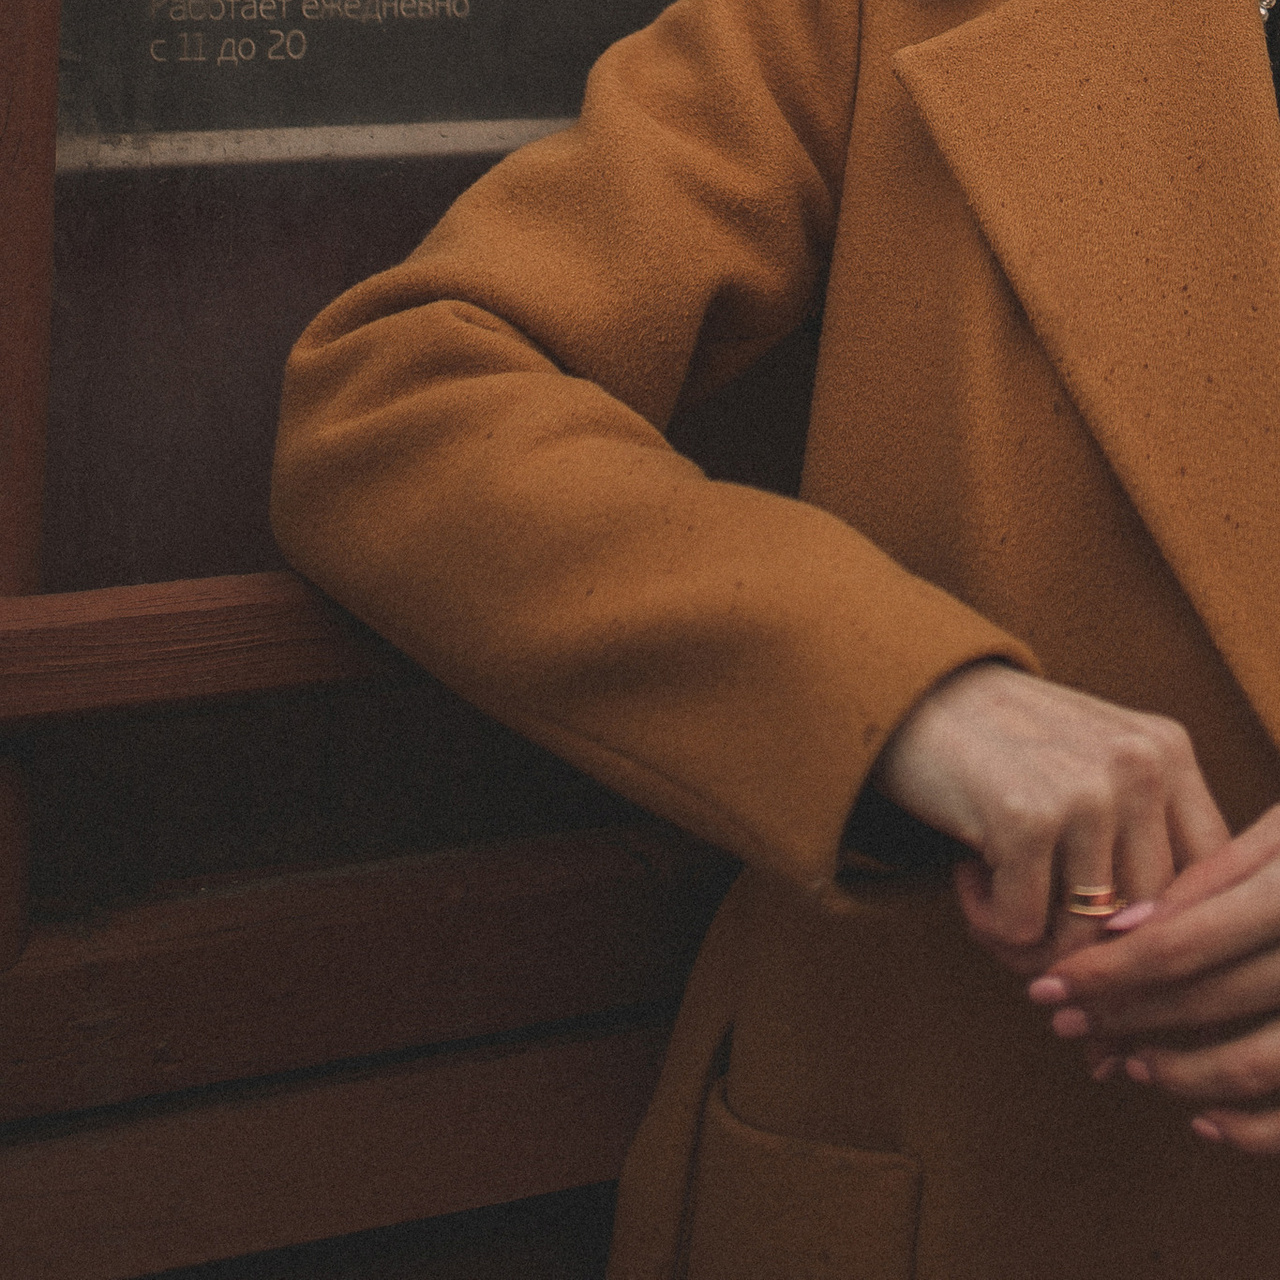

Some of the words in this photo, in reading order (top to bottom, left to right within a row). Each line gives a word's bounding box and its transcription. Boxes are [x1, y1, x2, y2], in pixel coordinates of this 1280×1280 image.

[148, 37, 168, 63] с
[177, 32, 208, 63] 11
[217, 37, 258, 67] до
[266, 28, 309, 62] 20
